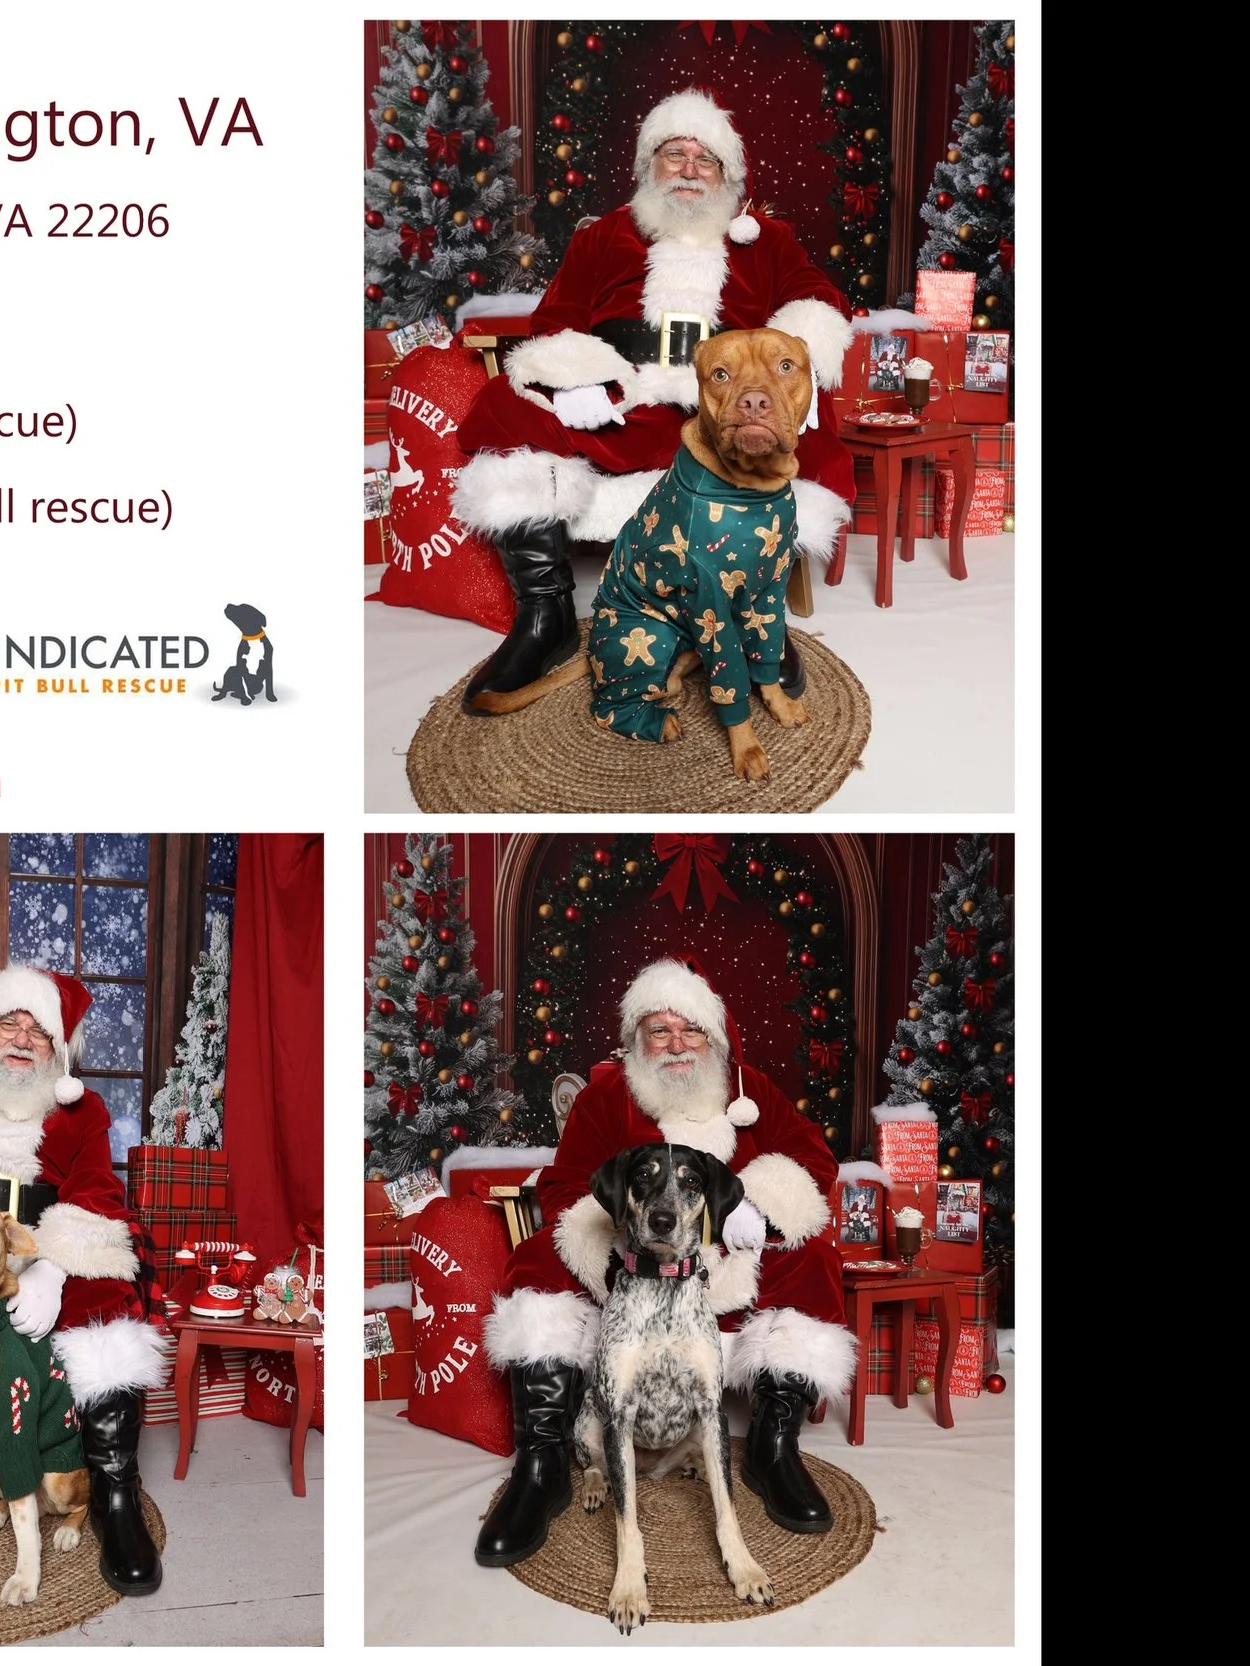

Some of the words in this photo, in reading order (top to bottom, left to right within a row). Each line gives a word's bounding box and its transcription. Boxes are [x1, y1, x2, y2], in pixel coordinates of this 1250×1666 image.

[389, 385, 458, 439] ELIVERY
[418, 509, 470, 570] POL
[446, 1303, 476, 1313] FROM
[249, 1354, 296, 1403] NORT
[430, 1336, 478, 1394] POLE
